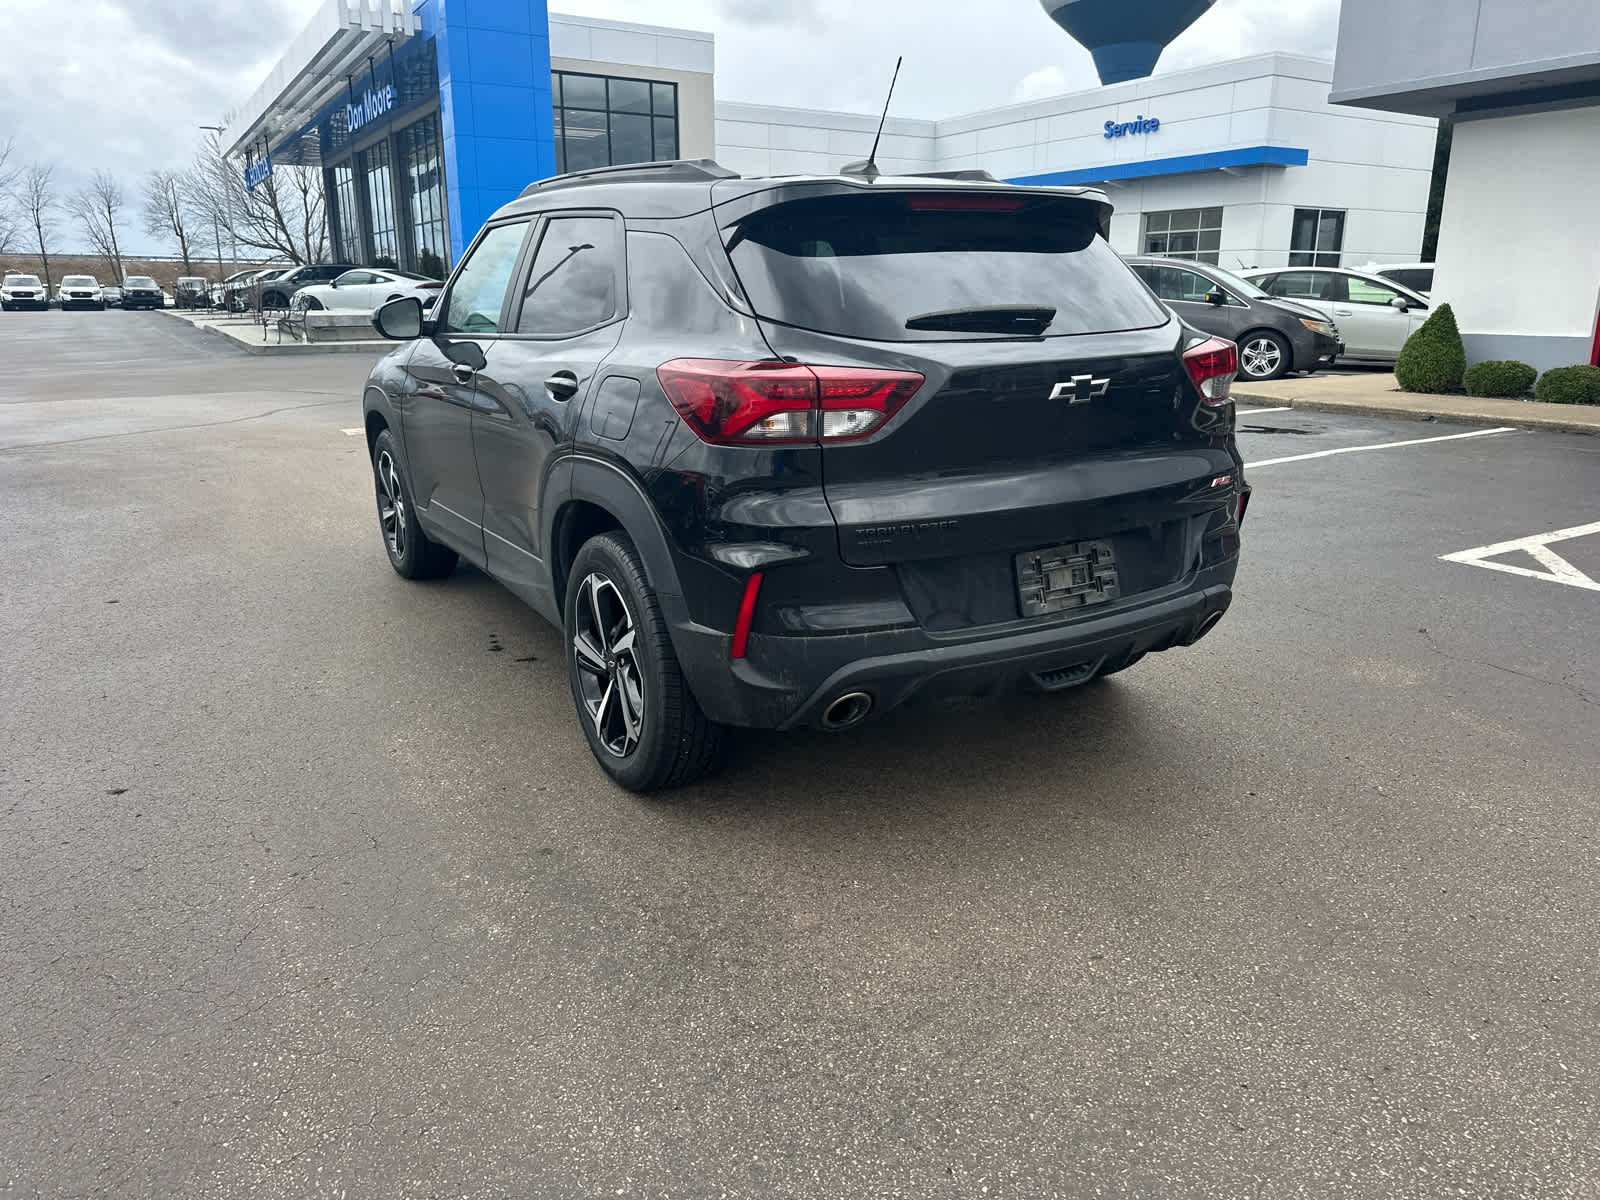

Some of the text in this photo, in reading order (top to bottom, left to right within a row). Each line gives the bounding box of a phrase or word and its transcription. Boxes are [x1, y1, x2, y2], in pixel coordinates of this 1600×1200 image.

[347, 85, 392, 132] Don Moore
[1104, 115, 1160, 139] Service
